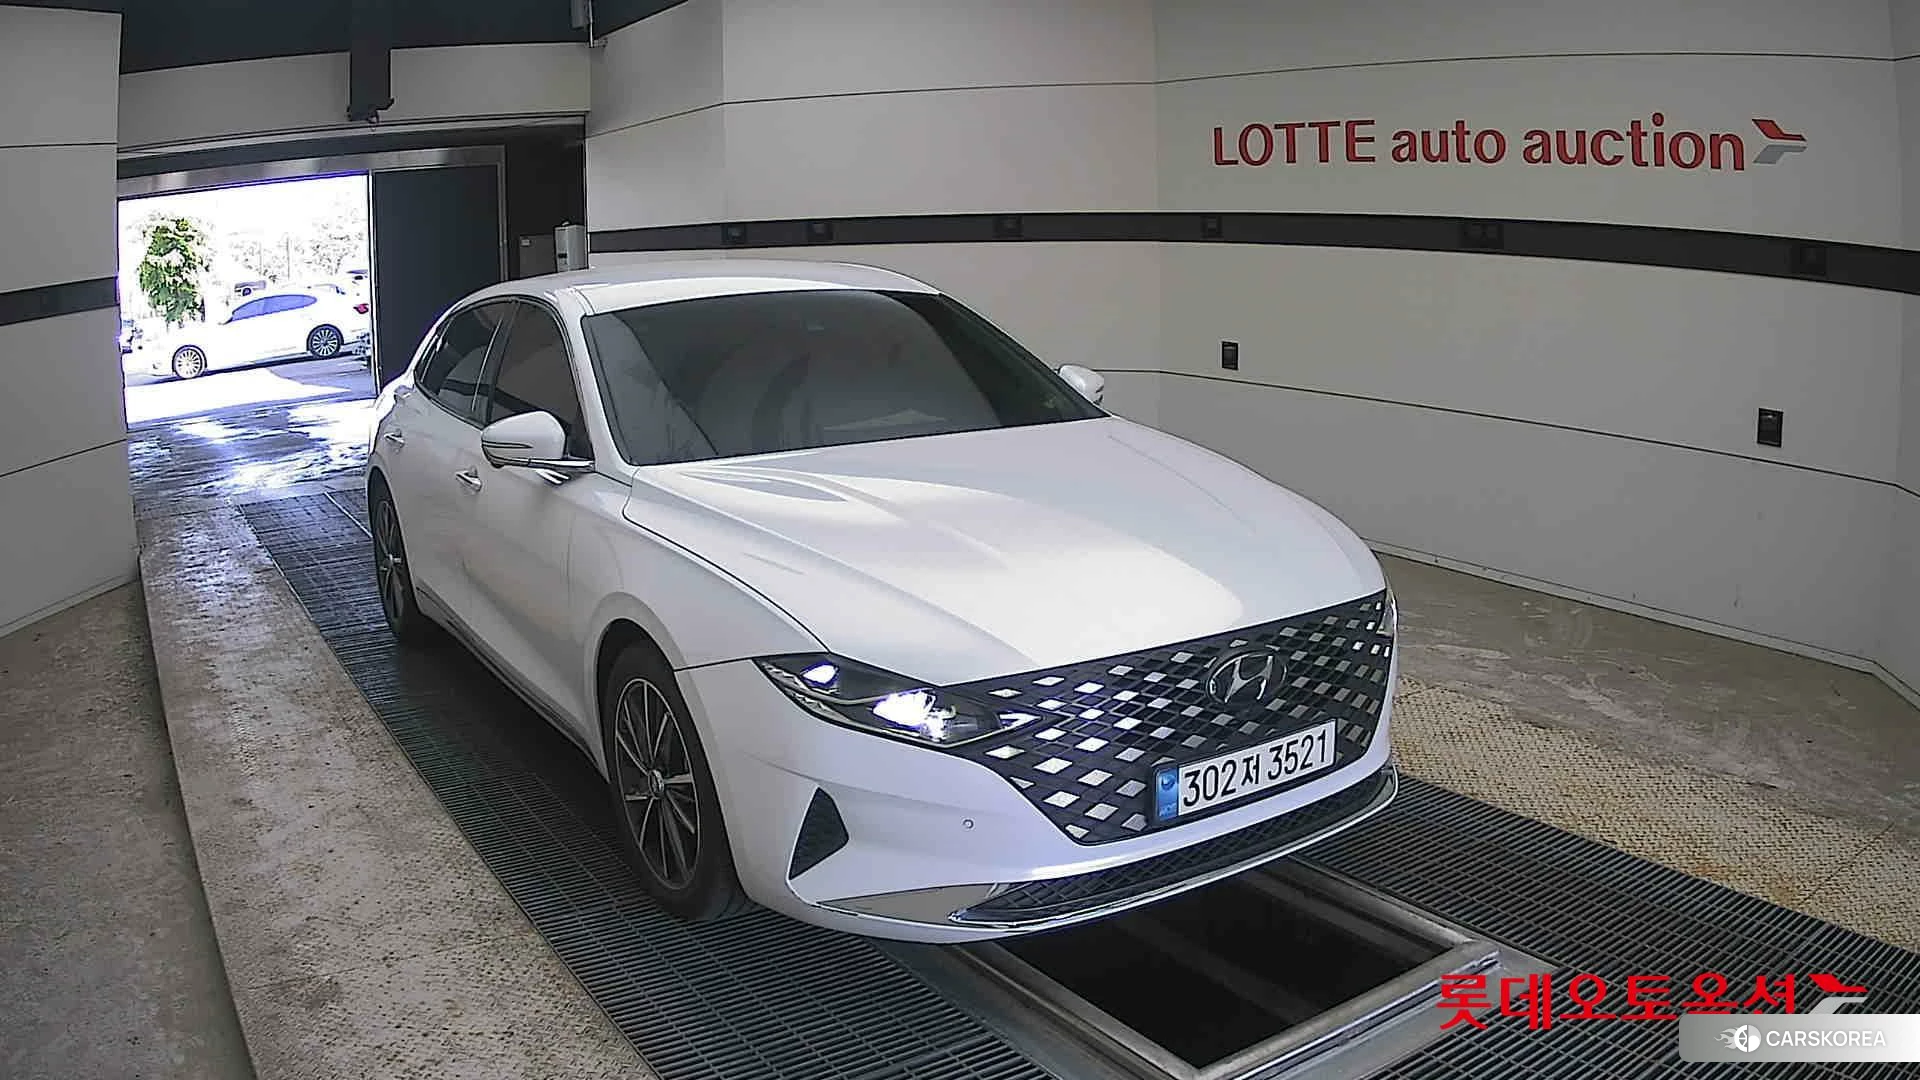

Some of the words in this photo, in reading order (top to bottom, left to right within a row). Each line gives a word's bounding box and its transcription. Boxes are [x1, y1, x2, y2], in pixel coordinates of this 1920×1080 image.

[1212, 119, 1376, 167] LOTTE
[1391, 119, 1507, 164] auto
[1522, 113, 1746, 171] auction
[1182, 752, 1261, 807] 302저
[1267, 730, 1327, 780] 3521
